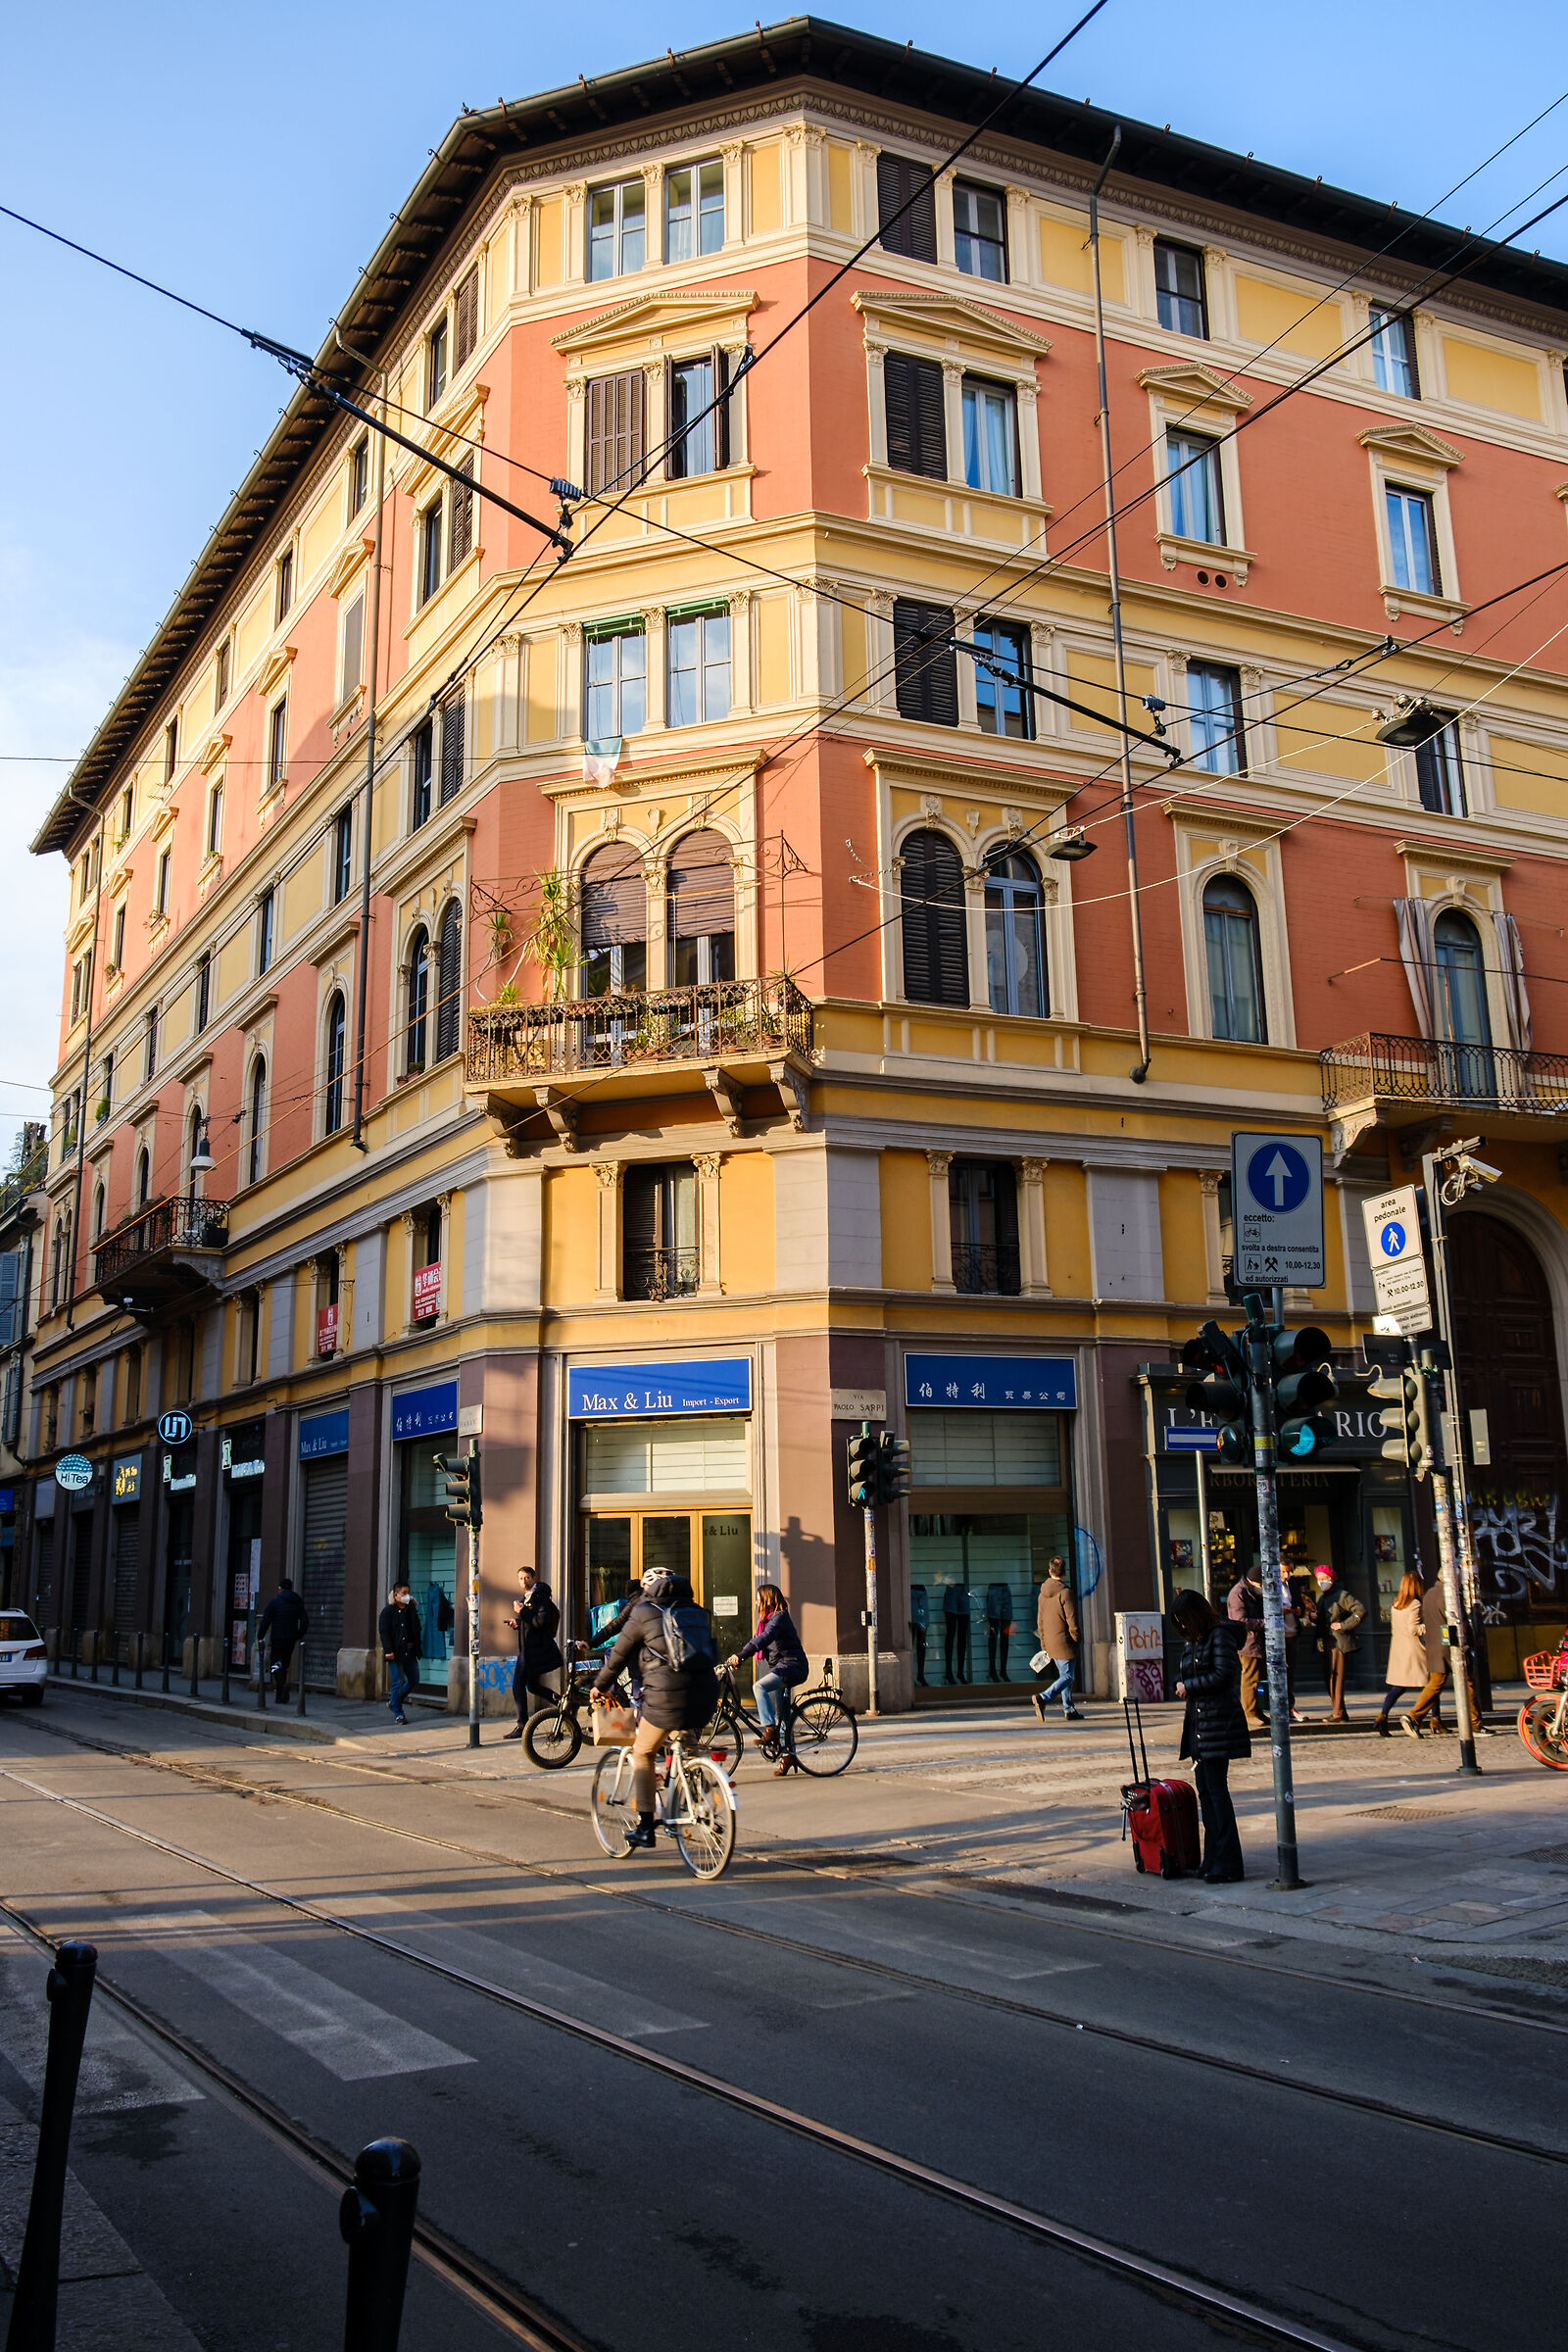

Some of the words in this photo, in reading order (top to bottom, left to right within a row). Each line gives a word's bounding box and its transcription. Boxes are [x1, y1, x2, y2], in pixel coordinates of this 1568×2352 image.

[1381, 1199, 1396, 1208] area
[1374, 1206, 1406, 1223] pedonale
[918, 1382, 986, 1399] 伯特利
[582, 1394, 618, 1411] Max
[624, 1392, 639, 1409] &
[645, 1391, 673, 1409] Liu
[682, 1398, 707, 1408] Import
[714, 1396, 740, 1406] Export
[71, 1474, 88, 1485] Tea
[719, 1525, 738, 1536] Liu
